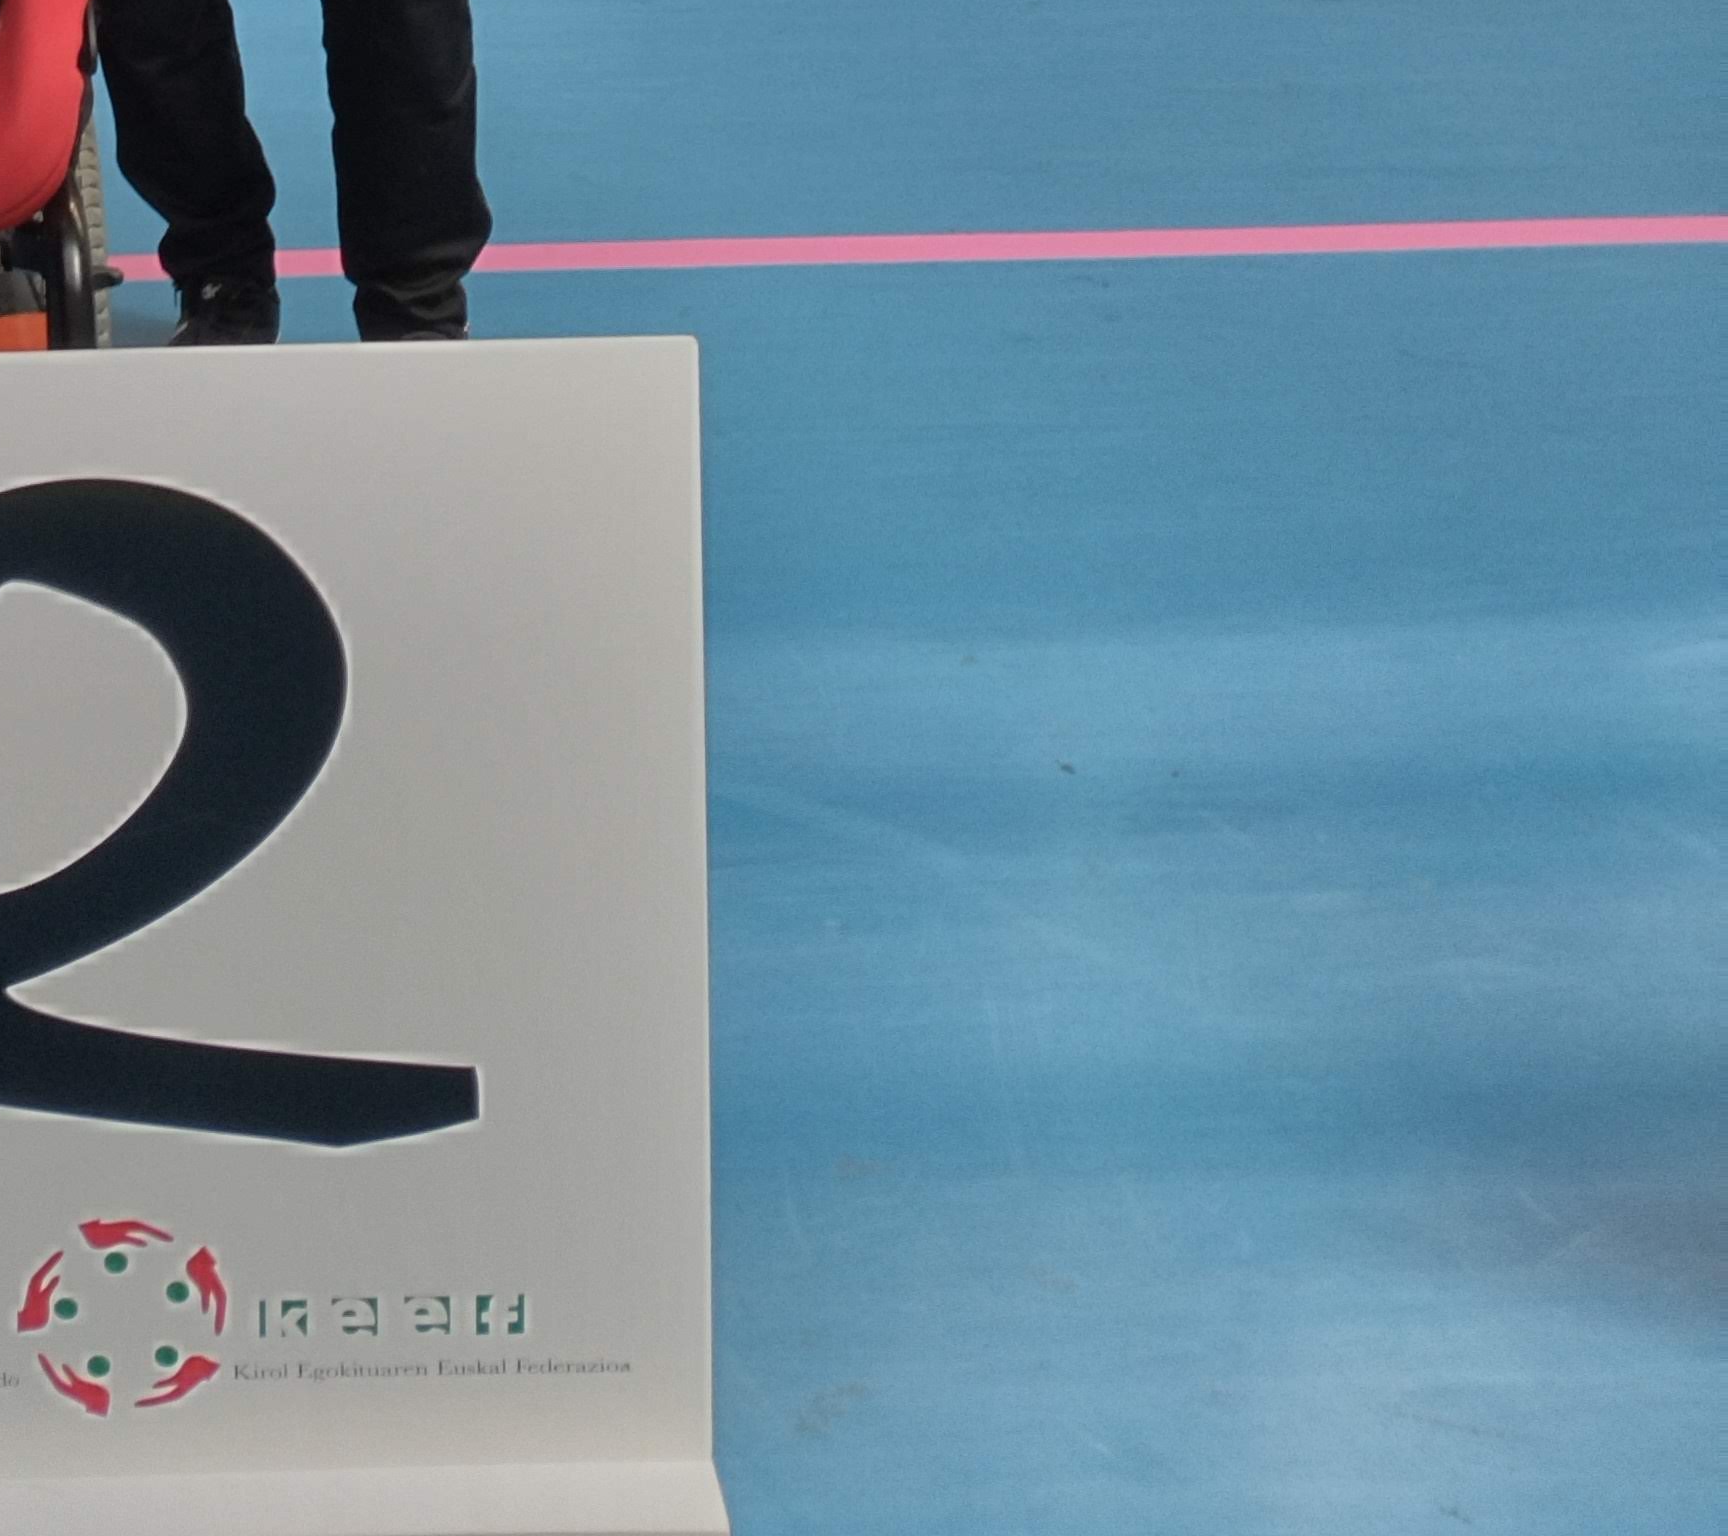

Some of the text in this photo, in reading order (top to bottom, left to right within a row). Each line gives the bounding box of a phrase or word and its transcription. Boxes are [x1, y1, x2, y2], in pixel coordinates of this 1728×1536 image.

[234, 1358, 632, 1382] Kirol Egokituaren Euskal Federazioa
